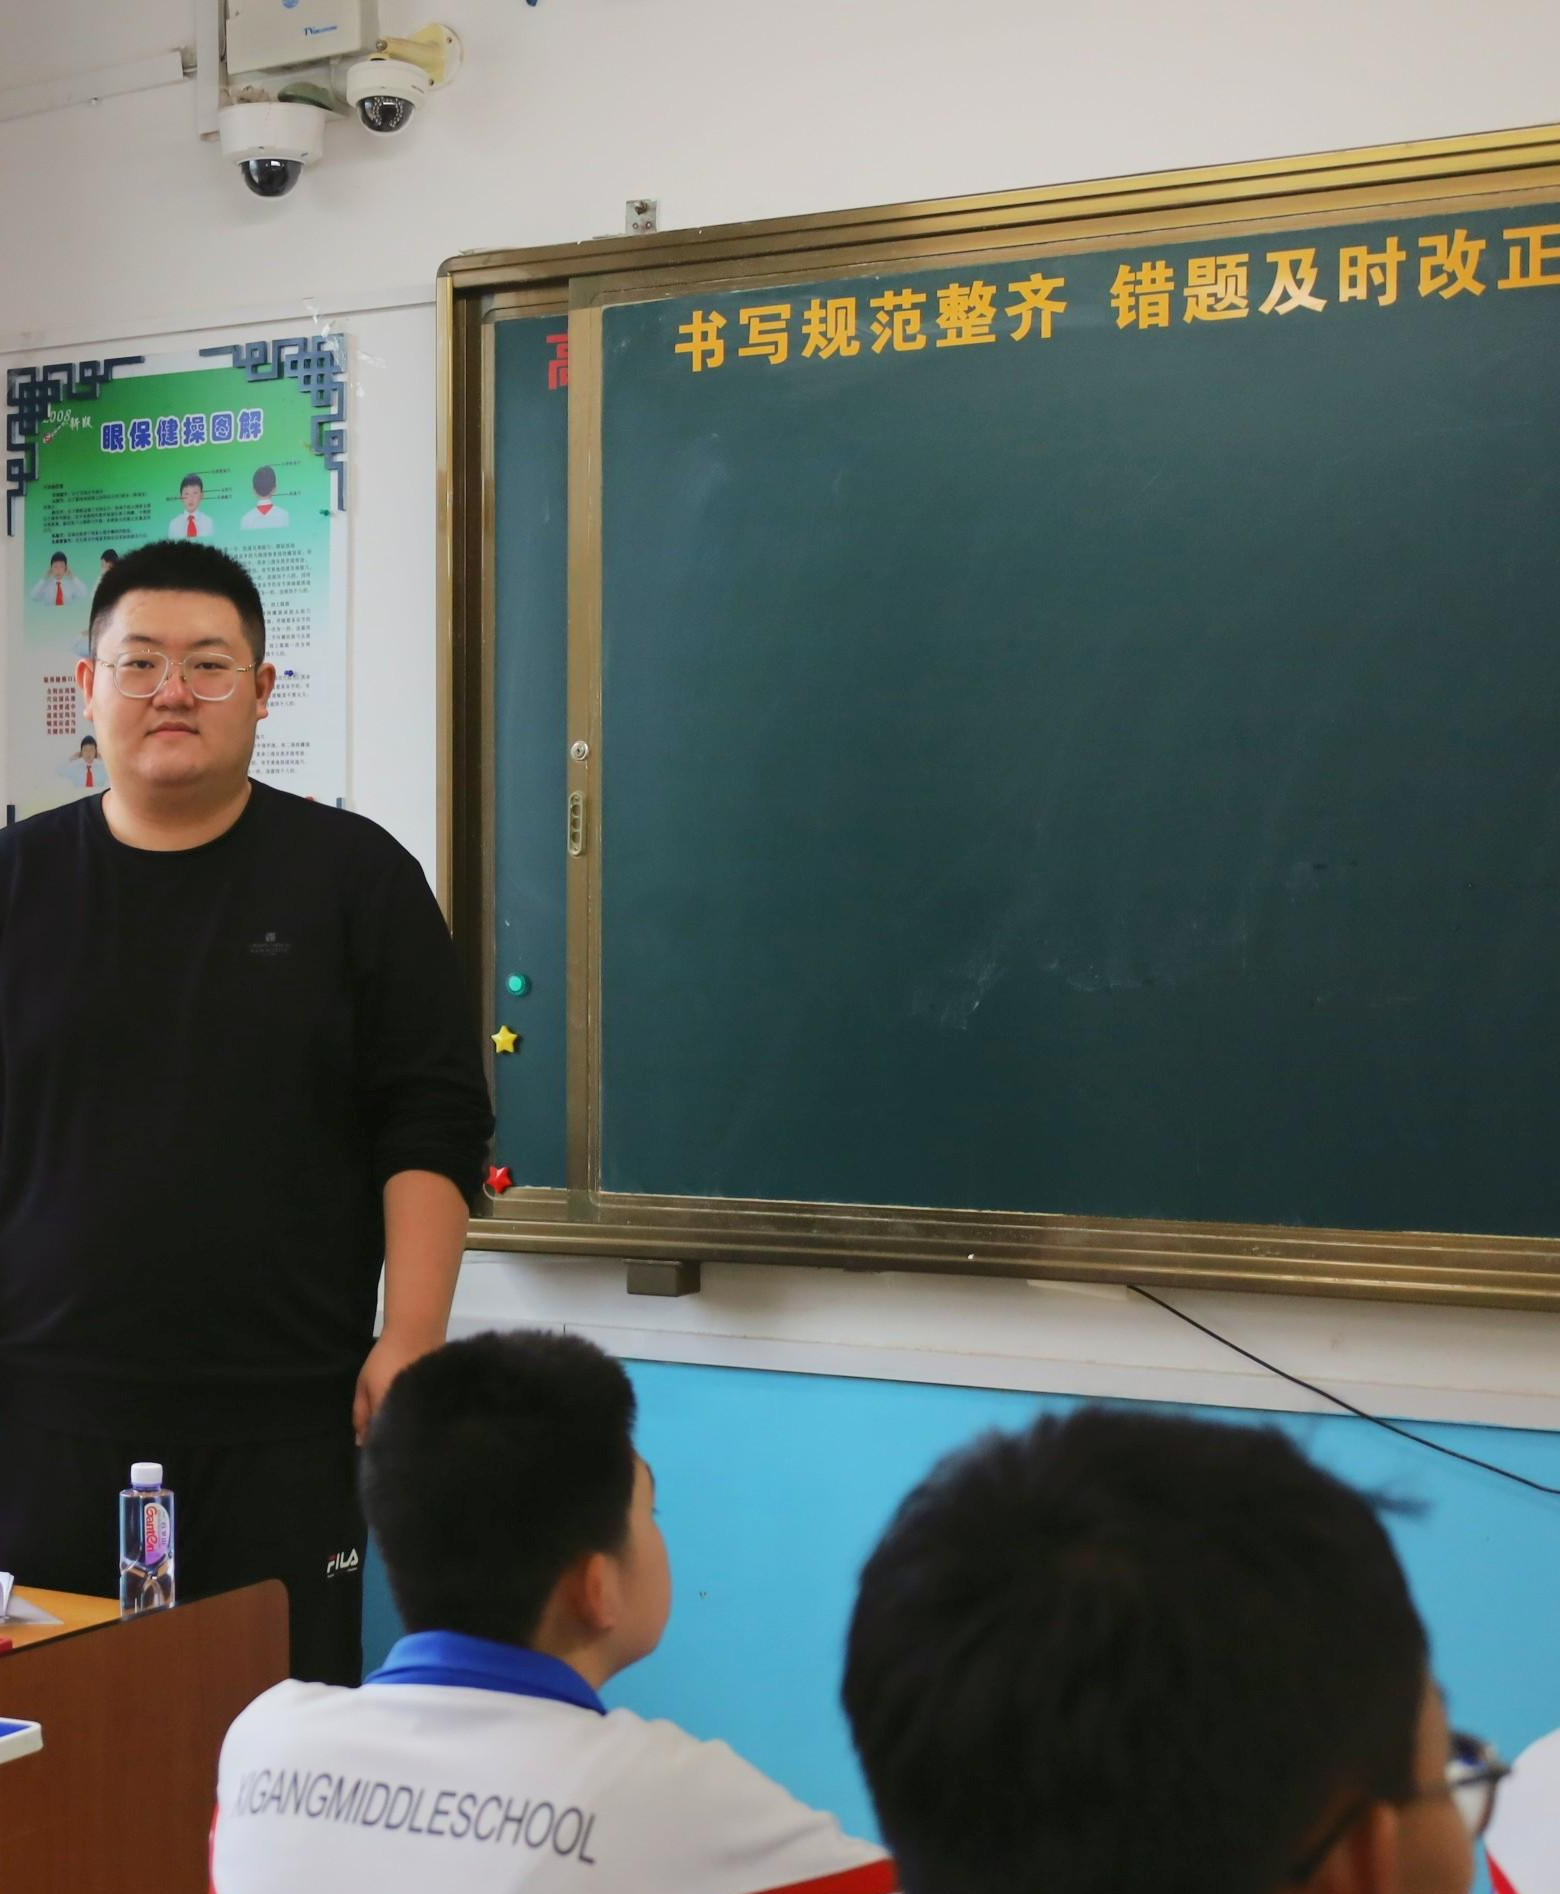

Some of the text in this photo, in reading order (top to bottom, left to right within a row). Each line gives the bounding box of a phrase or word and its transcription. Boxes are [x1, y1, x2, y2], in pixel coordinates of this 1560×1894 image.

[675, 275, 1068, 373] 书写规范整齐
[1109, 223, 1560, 332] 错题及时改正
[101, 408, 264, 453] 眼保健操图解
[326, 1547, 359, 1573] FILA
